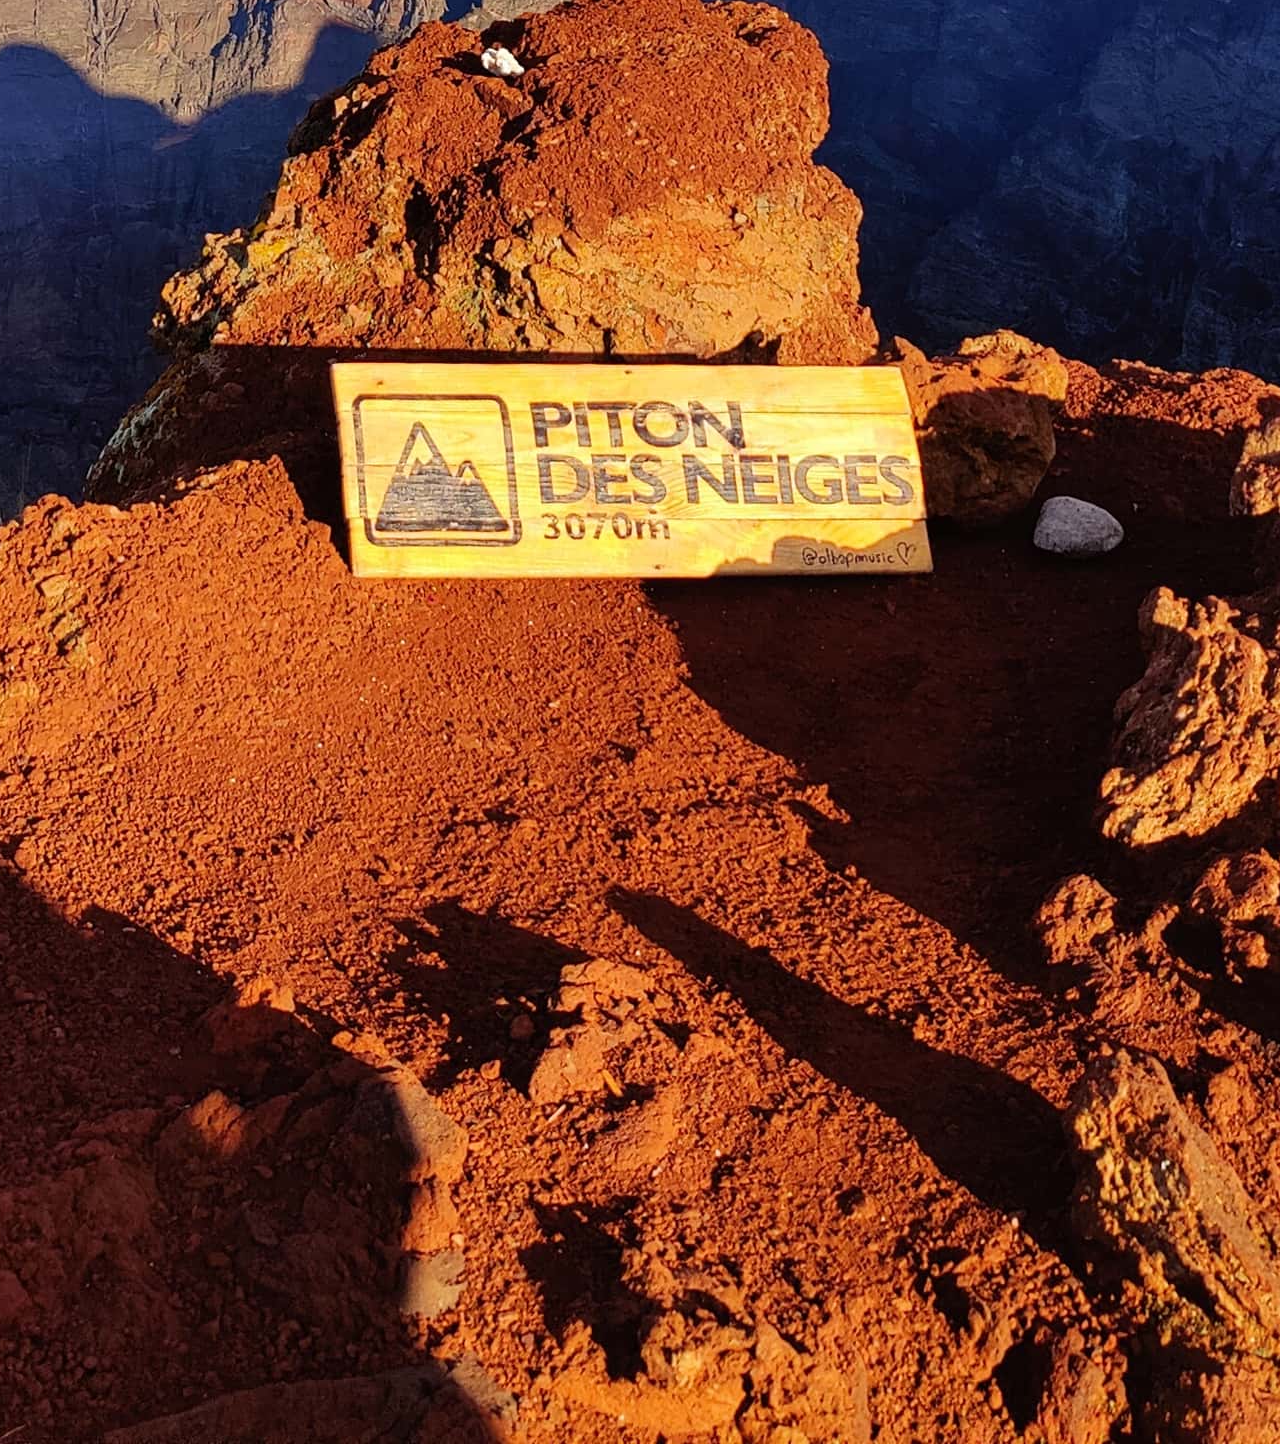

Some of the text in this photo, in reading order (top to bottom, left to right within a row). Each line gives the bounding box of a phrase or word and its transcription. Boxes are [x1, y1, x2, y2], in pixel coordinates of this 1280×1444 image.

[530, 401, 746, 449] PITON
[537, 454, 915, 506] DES NEIGES
[543, 511, 671, 541] 3070m
